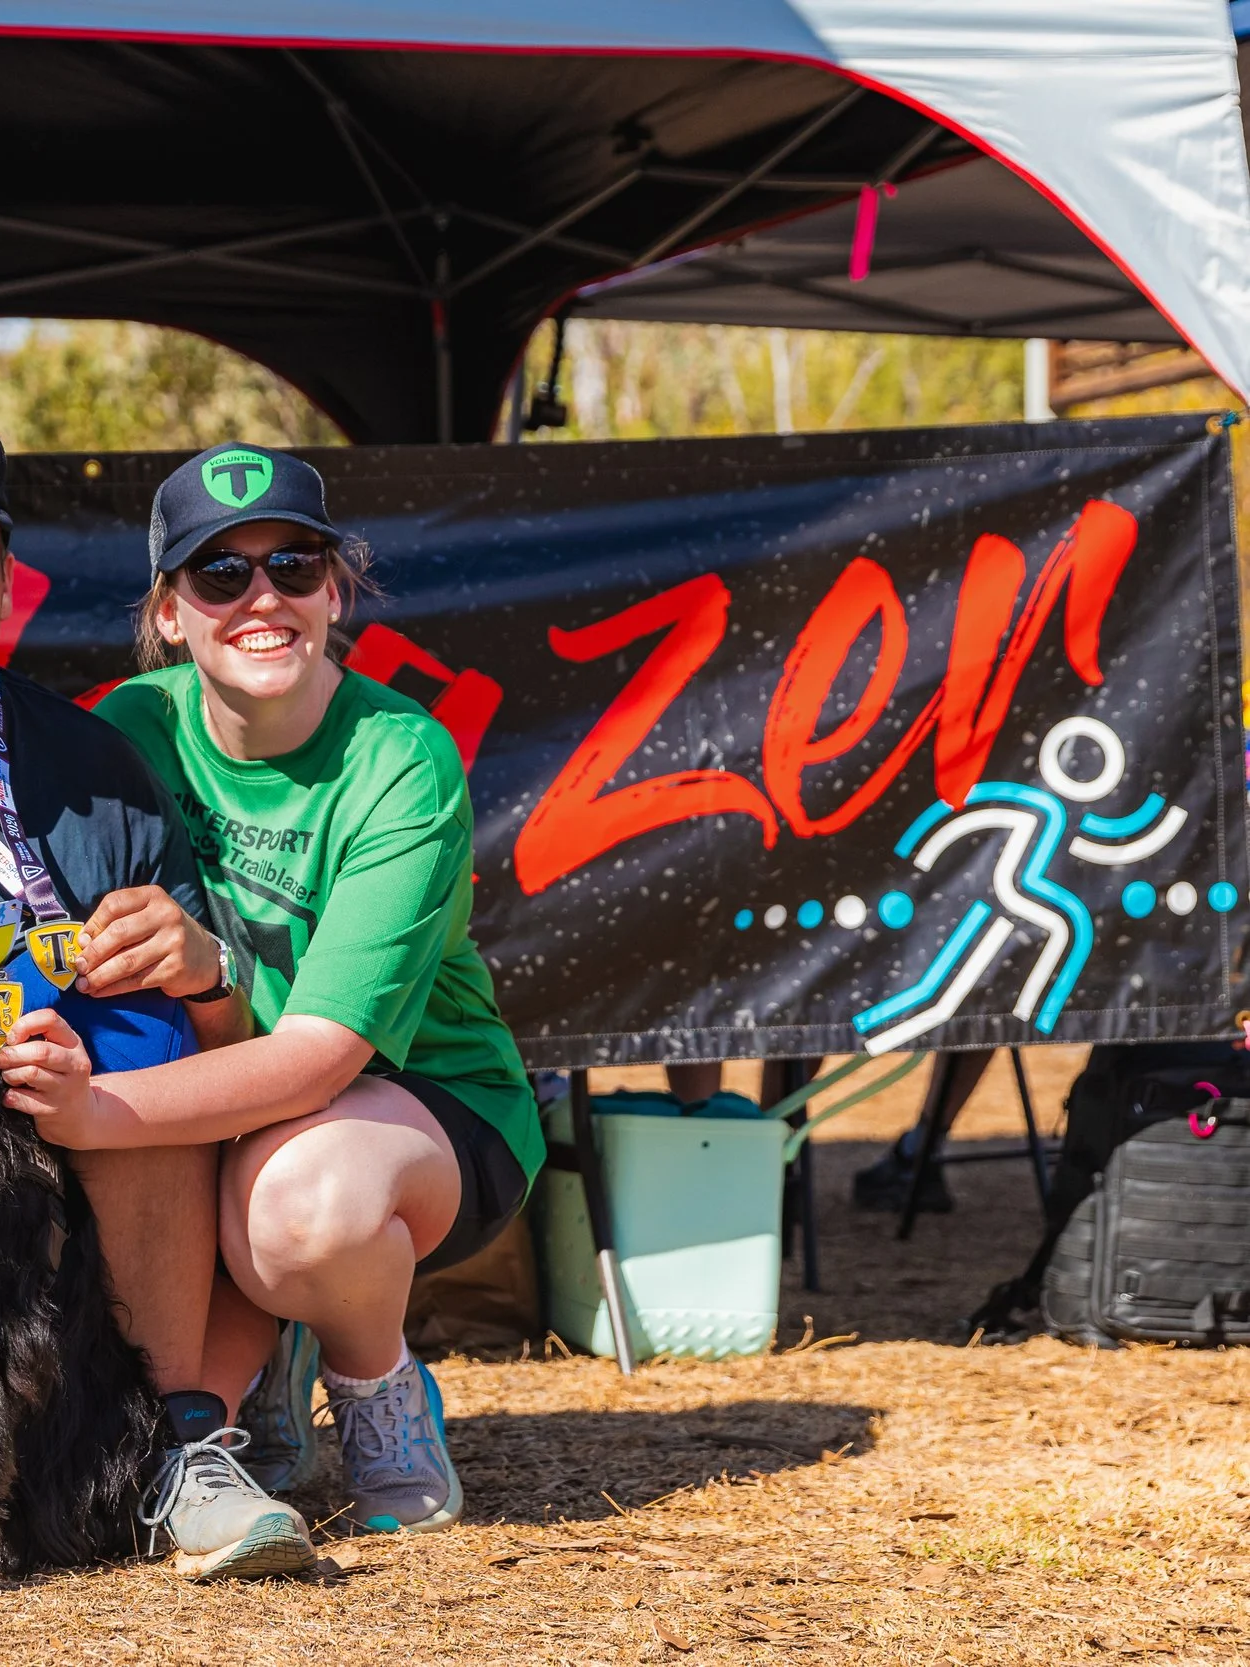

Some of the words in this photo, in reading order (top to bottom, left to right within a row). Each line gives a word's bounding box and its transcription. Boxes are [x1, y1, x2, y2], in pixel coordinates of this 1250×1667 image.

[209, 455, 264, 467] VOLUNTEER
[4, 813, 21, 839] 2026
[229, 847, 318, 904] Trailblazer
[37, 930, 75, 977] T
